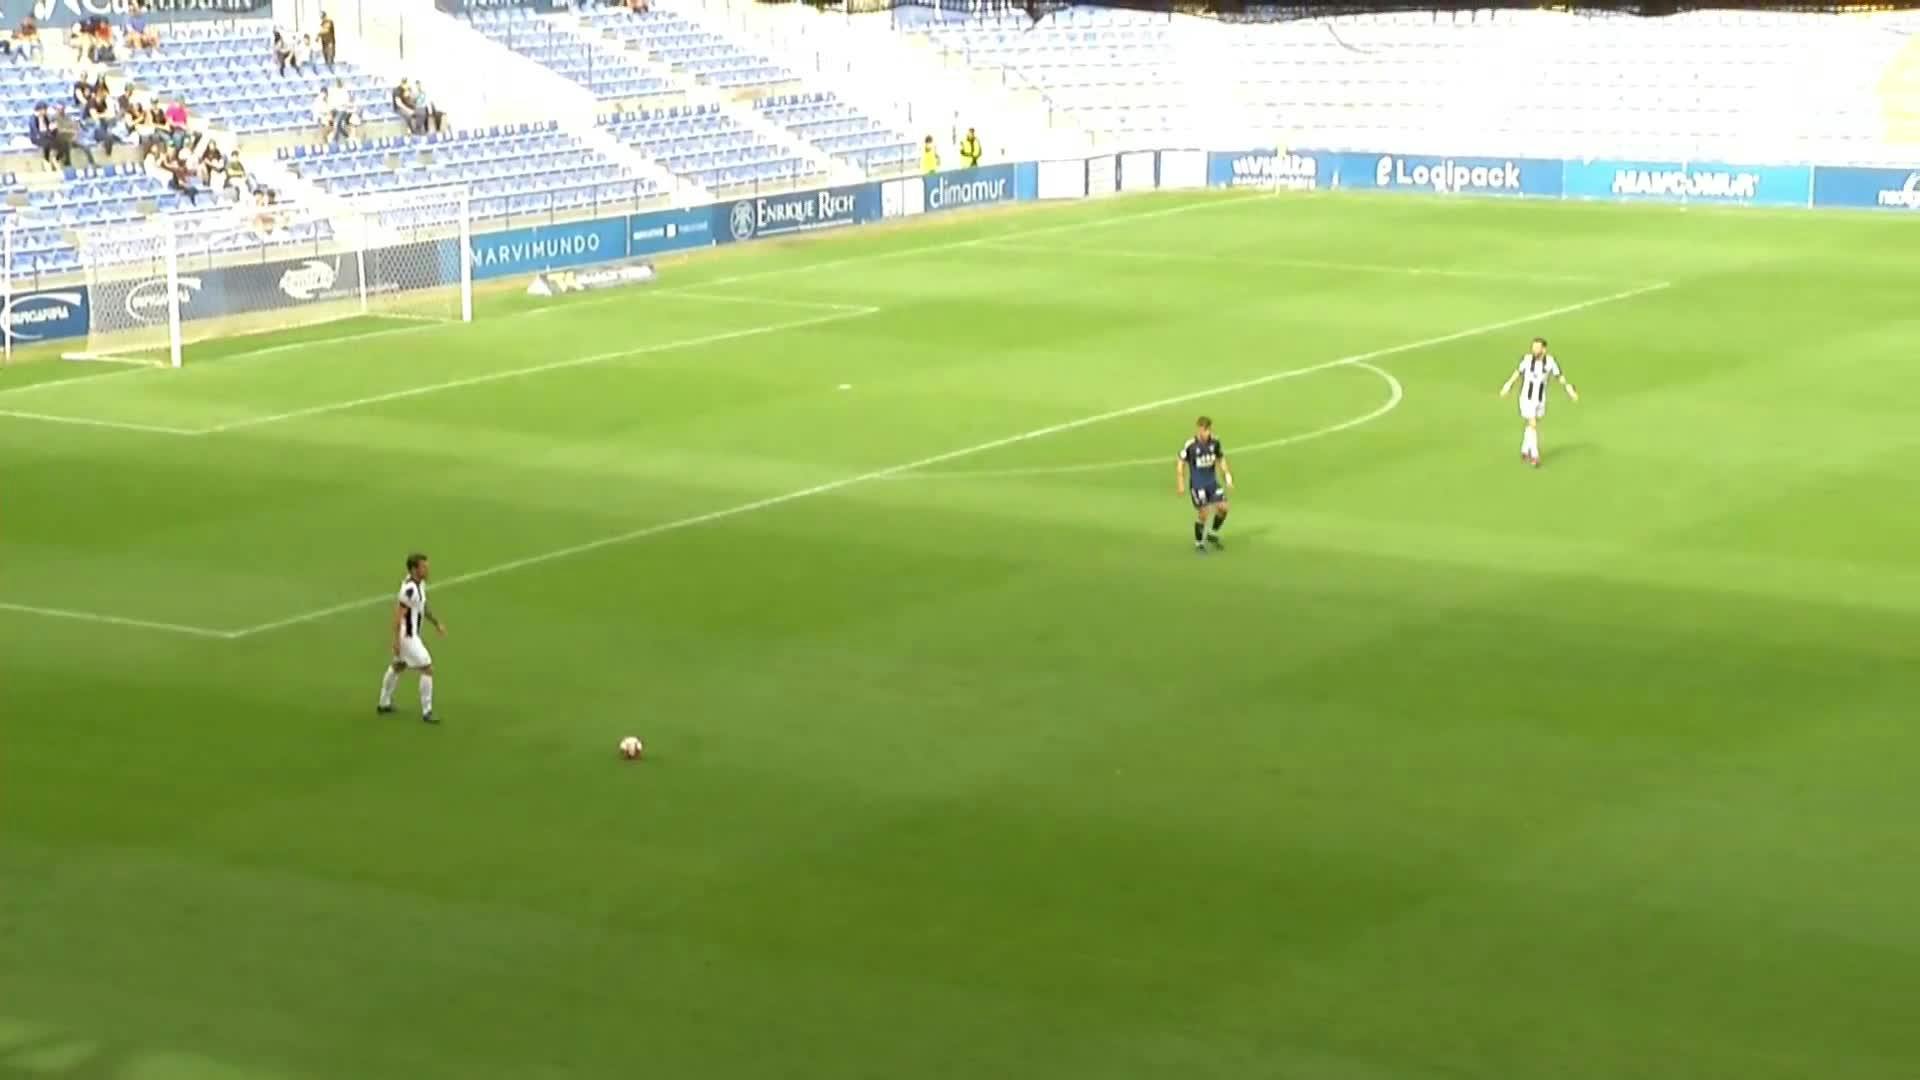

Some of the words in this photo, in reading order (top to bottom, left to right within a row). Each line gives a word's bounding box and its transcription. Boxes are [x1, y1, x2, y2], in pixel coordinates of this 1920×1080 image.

[930, 176, 1006, 208] climamur
[1396, 159, 1520, 193] Logipack
[757, 199, 814, 227] ENRIQUE
[818, 191, 854, 219] RICH
